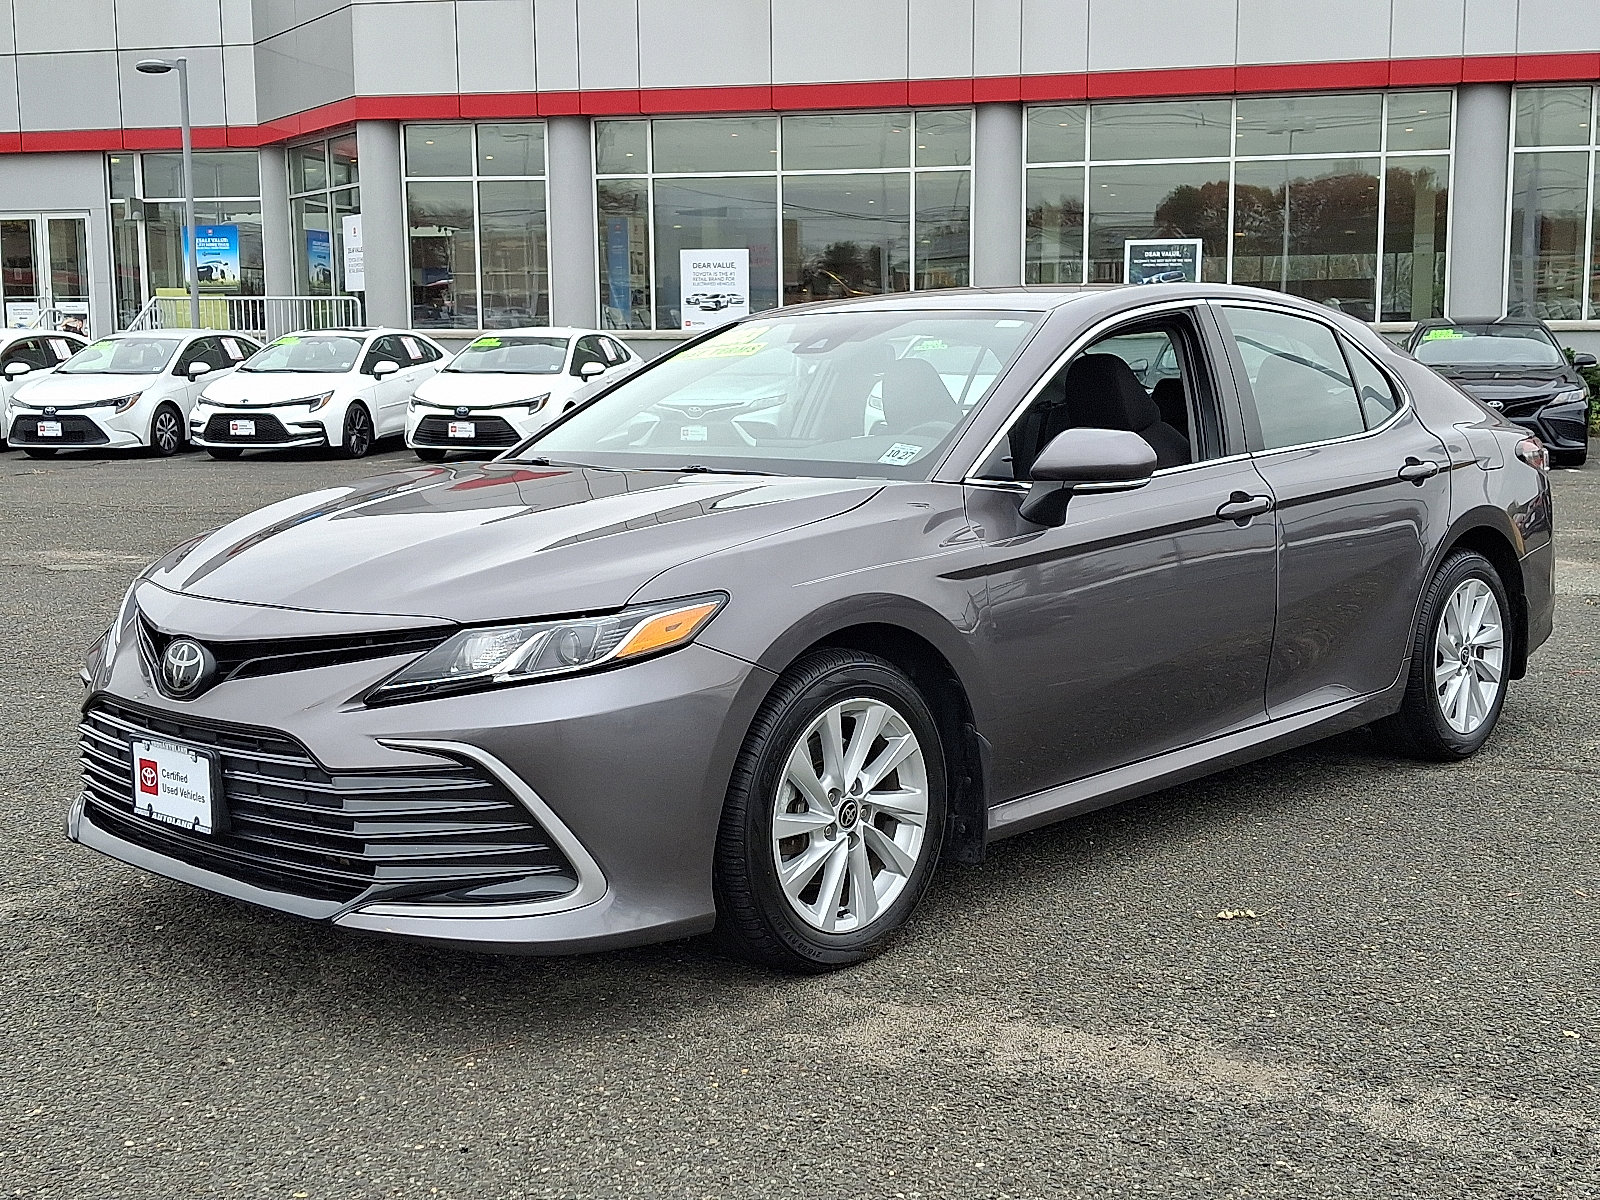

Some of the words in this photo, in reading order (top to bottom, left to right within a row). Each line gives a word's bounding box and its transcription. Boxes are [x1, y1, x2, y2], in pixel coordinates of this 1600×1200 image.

[712, 261, 737, 269] VALUE,
[161, 768, 188, 784] Certified
[161, 783, 179, 796] Used
[179, 786, 205, 804] Vehicles
[151, 811, 193, 830] AUTOLAND
